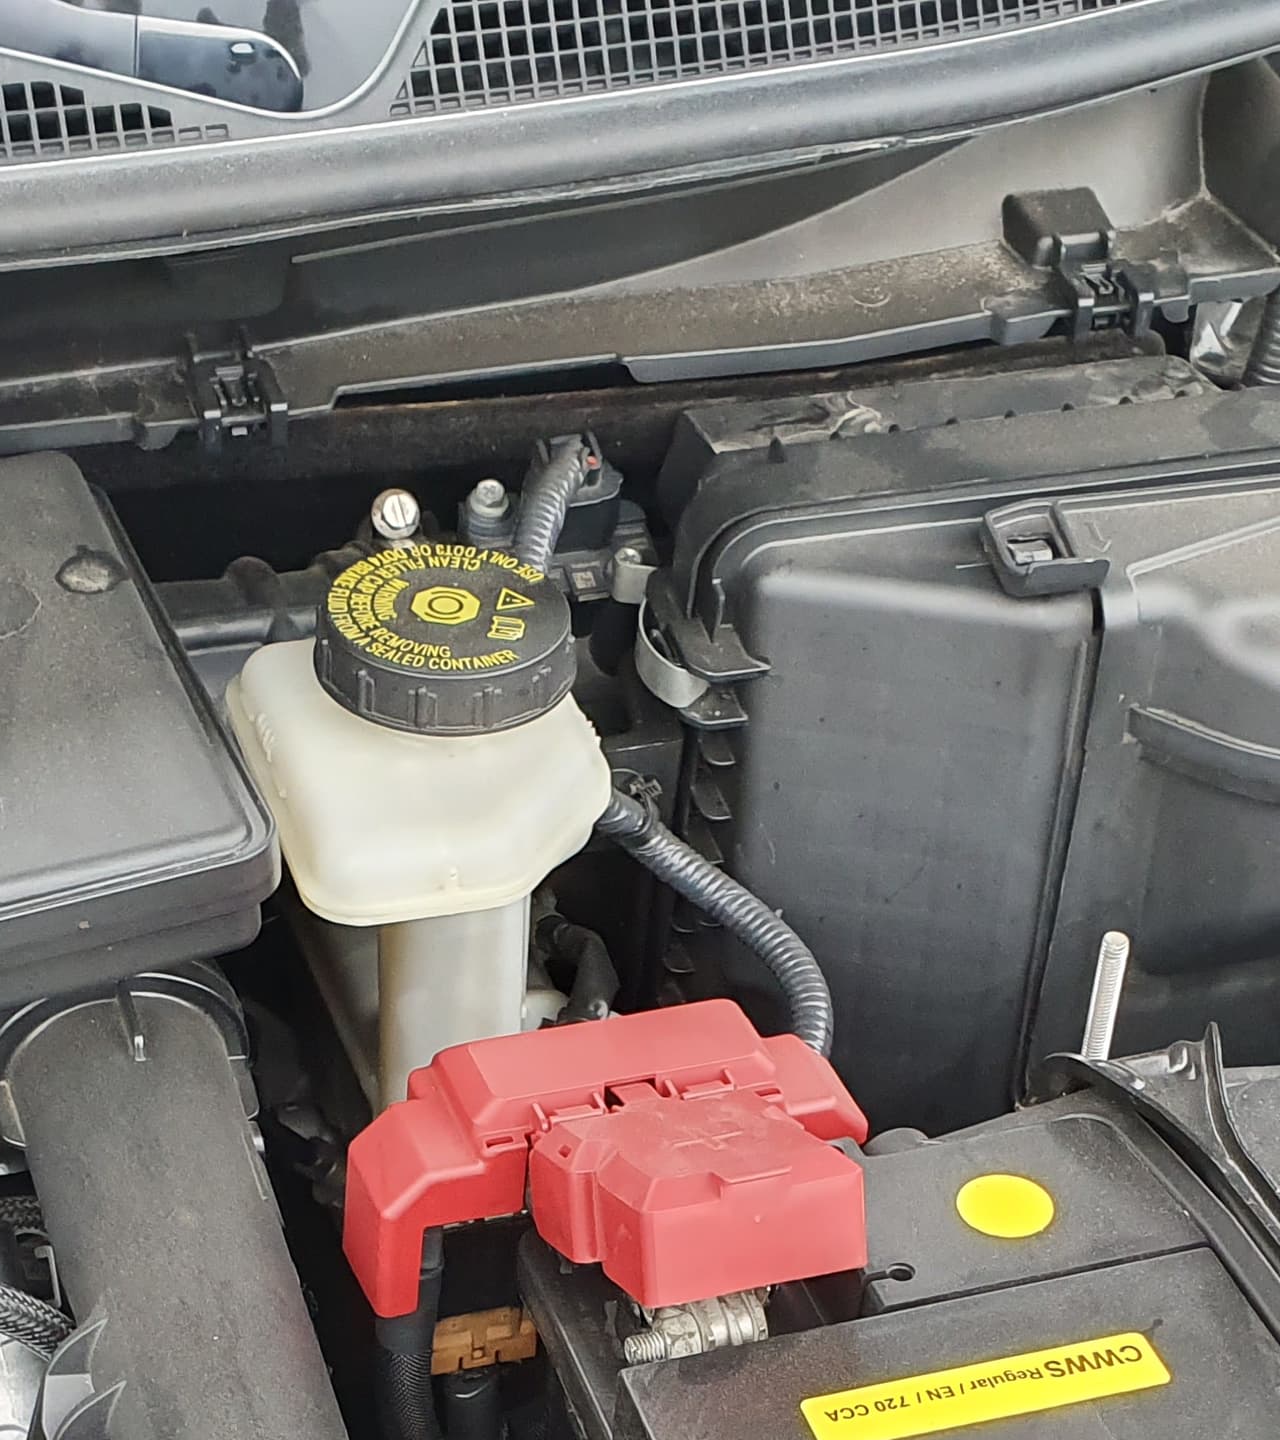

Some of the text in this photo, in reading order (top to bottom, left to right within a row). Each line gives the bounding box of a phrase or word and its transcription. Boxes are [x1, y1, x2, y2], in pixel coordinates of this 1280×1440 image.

[327, 543, 545, 671] USE ONLY DOT3 OR DOT4 BRAKE FLUID FROM A SEALED CONTAINER
[350, 555, 481, 658] CLEAN FILLER CAP BEFORE REMOVING
[373, 577, 410, 621] WARNING
[1043, 1345, 1143, 1378] CWWS
[925, 1385, 956, 1401] EN
[970, 1366, 1044, 1391] Regular
[824, 1404, 870, 1422] CCA
[874, 1395, 911, 1413] 720
